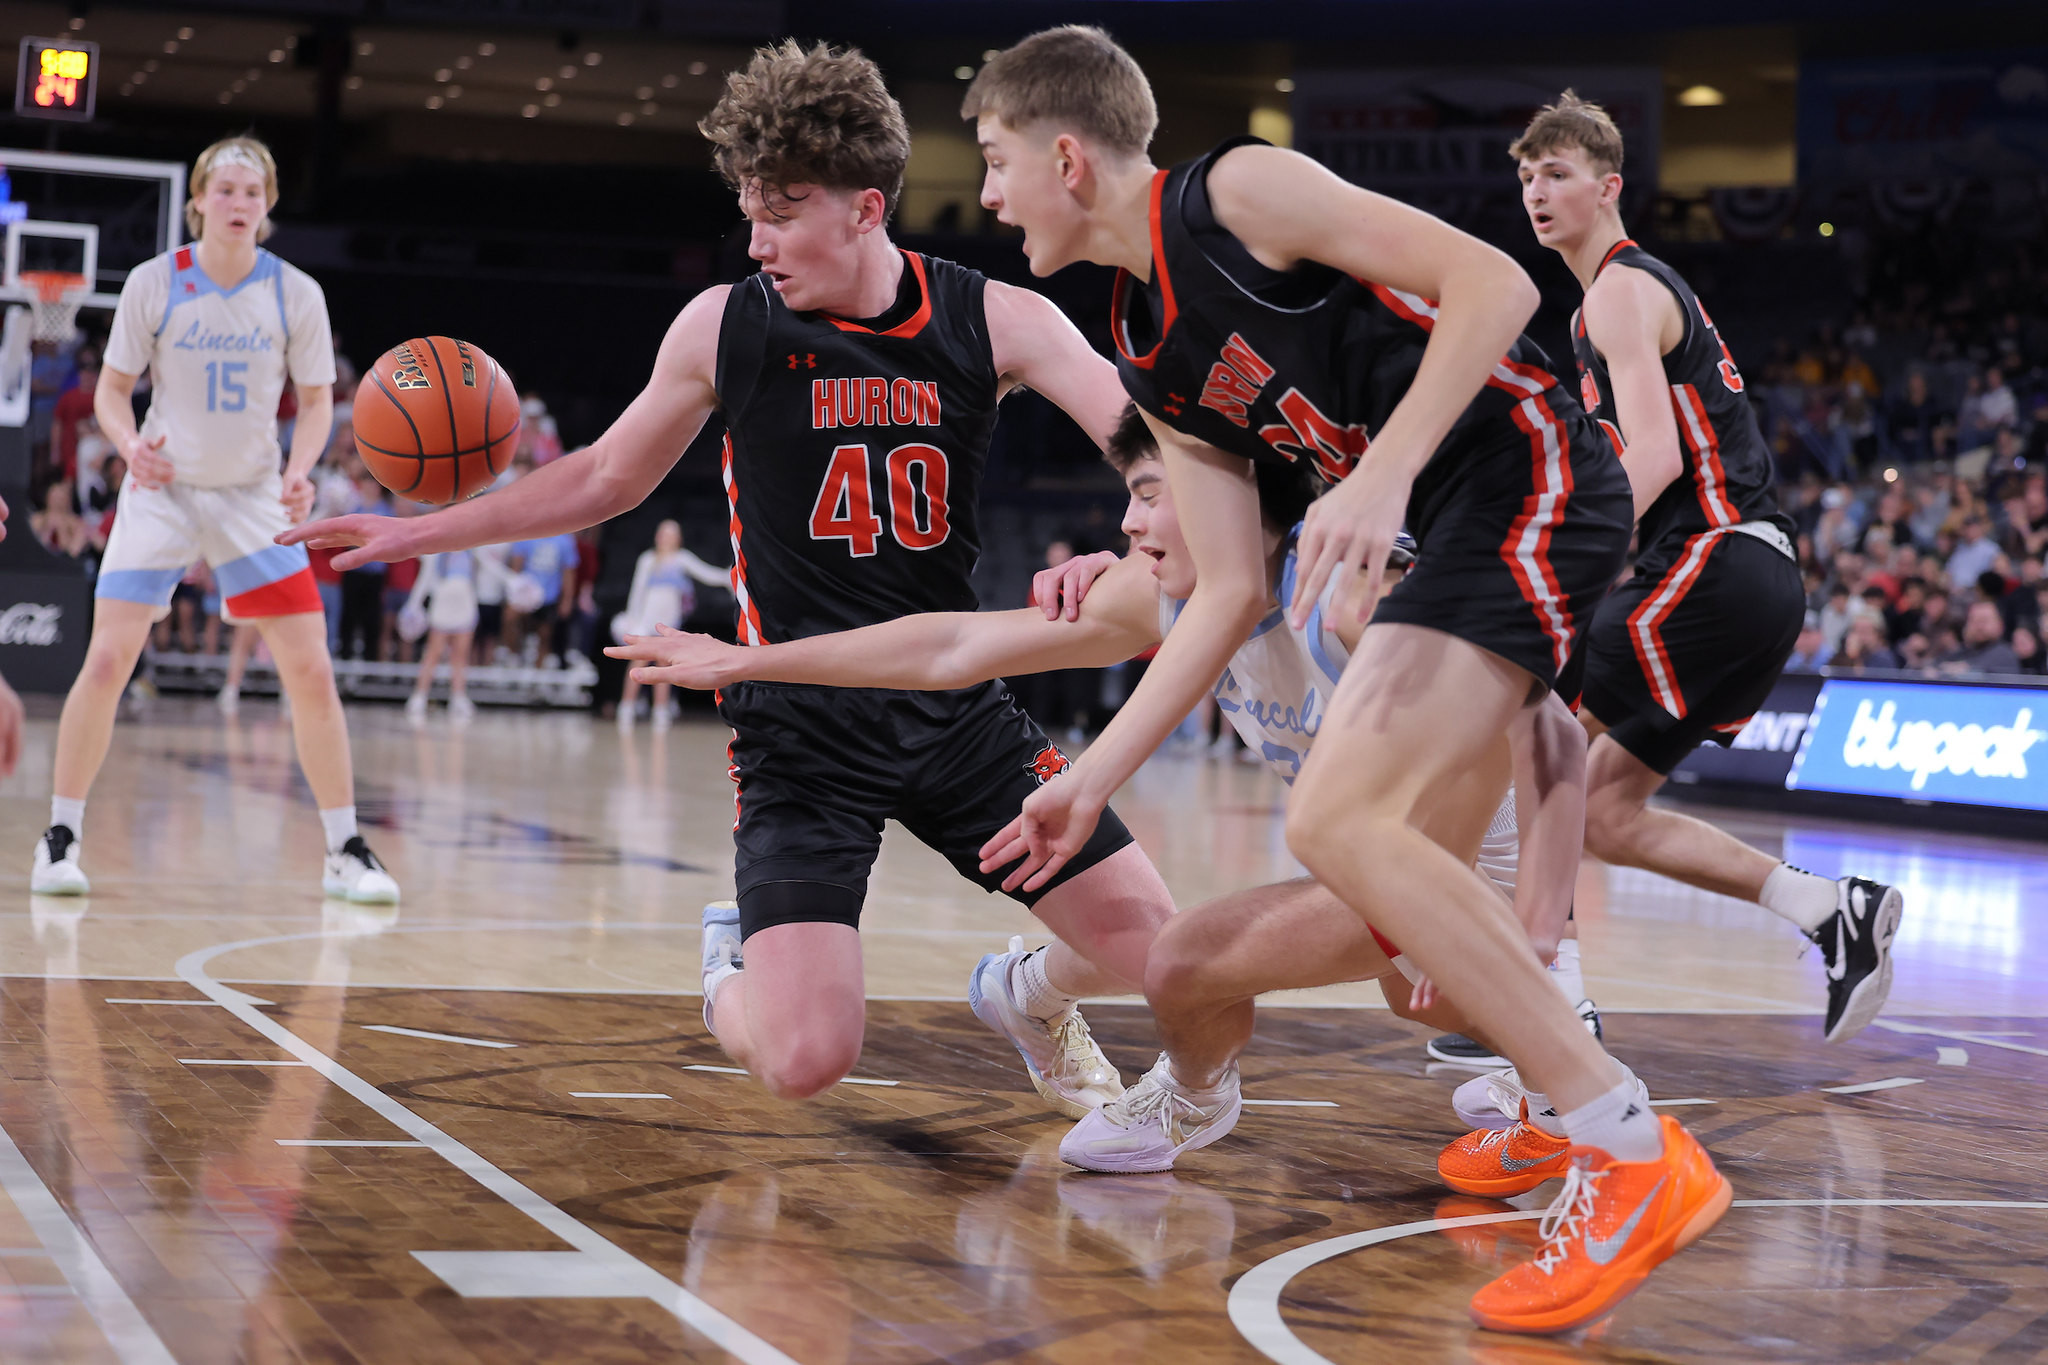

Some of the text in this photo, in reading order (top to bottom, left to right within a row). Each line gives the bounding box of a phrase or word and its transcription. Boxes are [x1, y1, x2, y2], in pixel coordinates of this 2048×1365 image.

[174, 320, 272, 351] Lincoln
[205, 361, 248, 412] 15
[812, 376, 942, 429] HURON
[808, 442, 950, 558] 40
